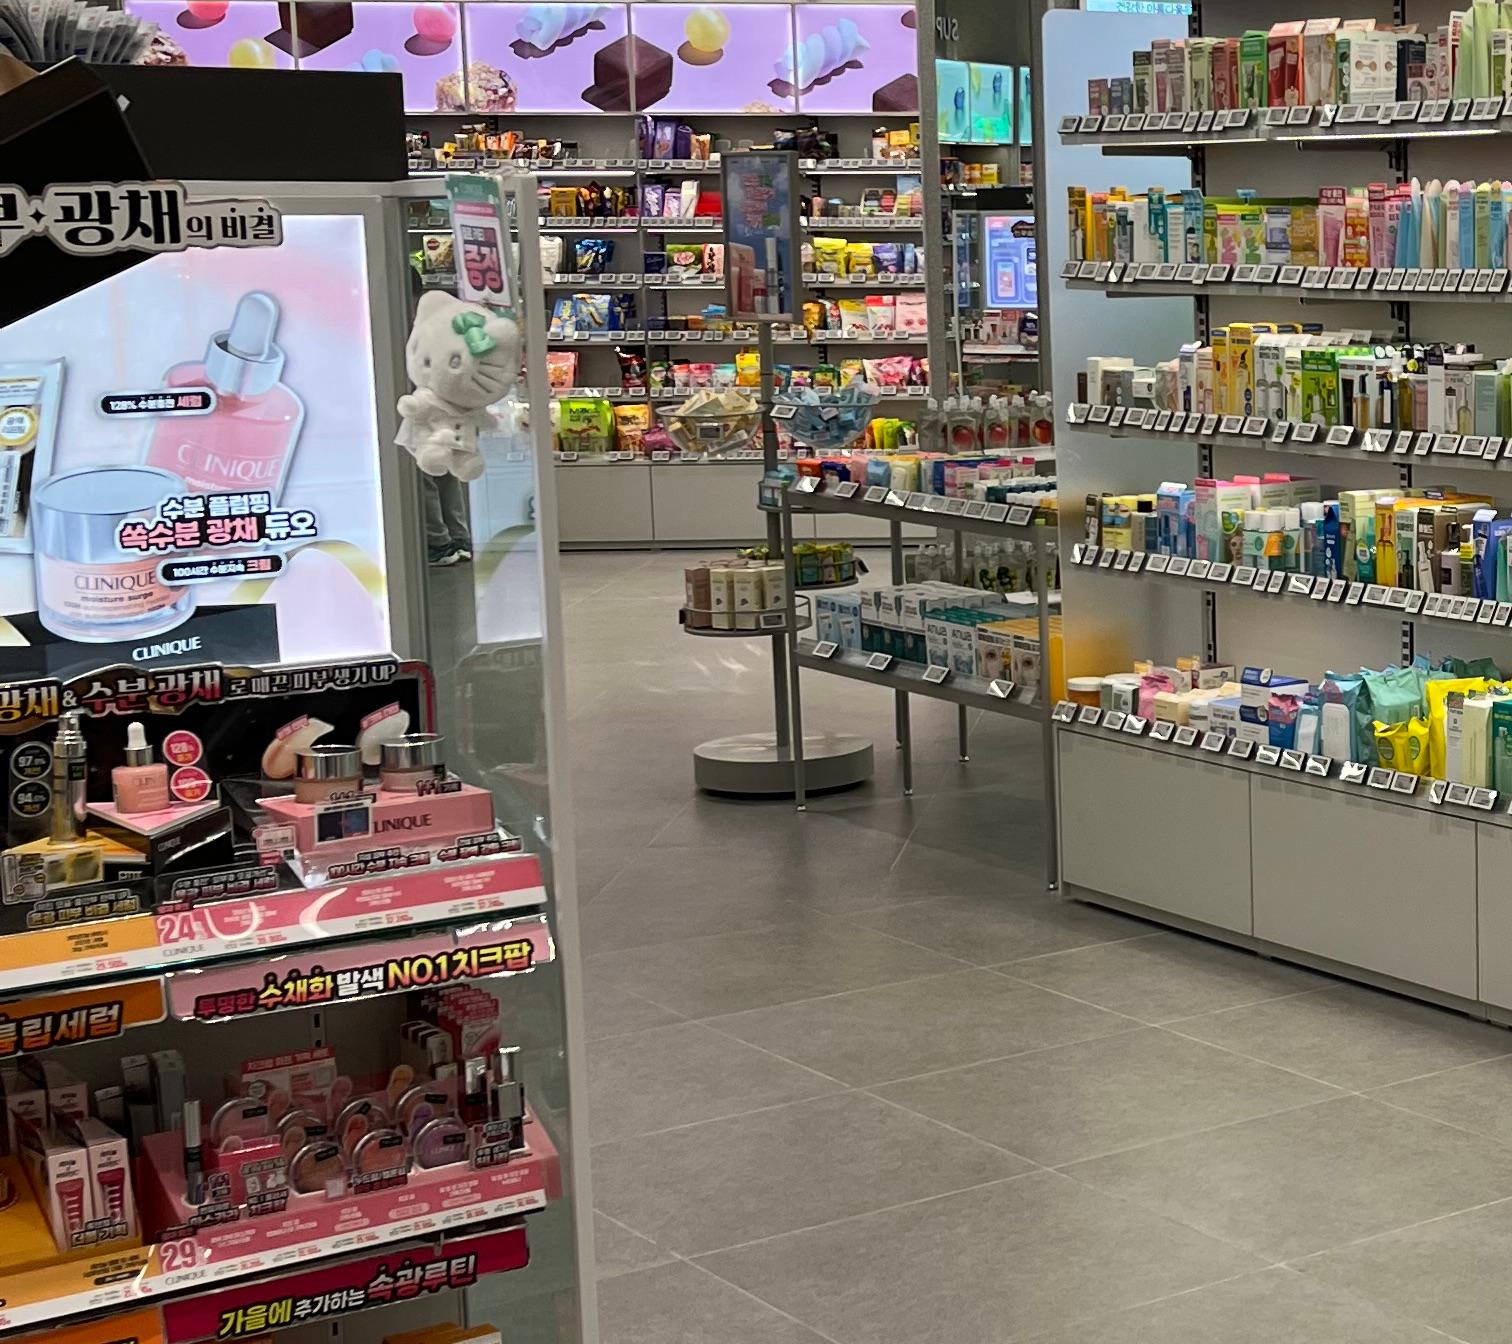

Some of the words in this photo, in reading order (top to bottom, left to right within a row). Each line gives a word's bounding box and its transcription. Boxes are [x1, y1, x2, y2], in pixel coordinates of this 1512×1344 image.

[221, 207, 275, 241] 비결
[163, 498, 205, 519] 수분
[207, 516, 258, 543] 광채
[264, 511, 316, 538] 듀오
[132, 636, 201, 661] CLINIQUE
[62, 690, 78, 707] &
[82, 678, 149, 712] 수분
[251, 674, 288, 693] 매끈
[293, 670, 328, 689] 피부
[334, 667, 367, 685] 생기
[372, 664, 396, 680] UP
[374, 813, 432, 833] LINIQUE
[199, 994, 254, 1018] 투명한
[336, 970, 385, 996] 발색
[388, 956, 447, 988] NO.1
[452, 942, 532, 975] 치크팝
[218, 1299, 292, 1337] 가을에
[294, 1289, 365, 1319] 추가하는
